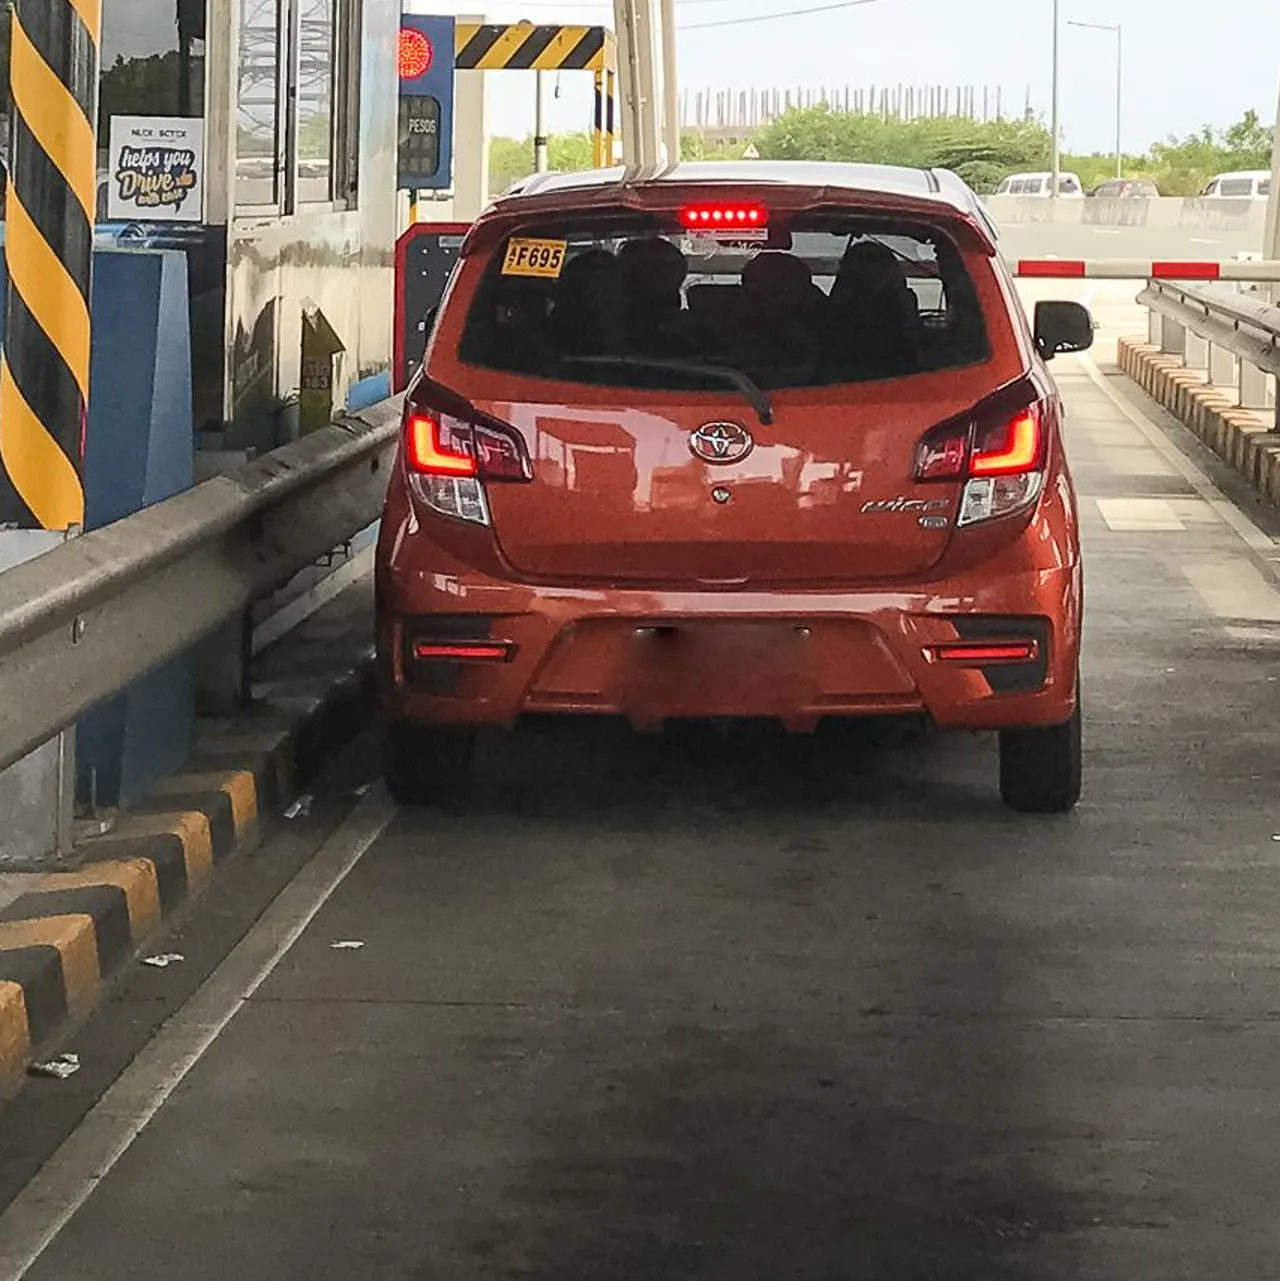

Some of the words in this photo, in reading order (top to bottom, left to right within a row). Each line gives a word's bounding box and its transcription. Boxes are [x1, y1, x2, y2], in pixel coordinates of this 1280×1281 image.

[409, 118, 436, 133] PESOS
[122, 149, 160, 173] helps
[163, 151, 190, 173] you
[117, 170, 175, 197] Drive
[516, 247, 562, 269] F695
